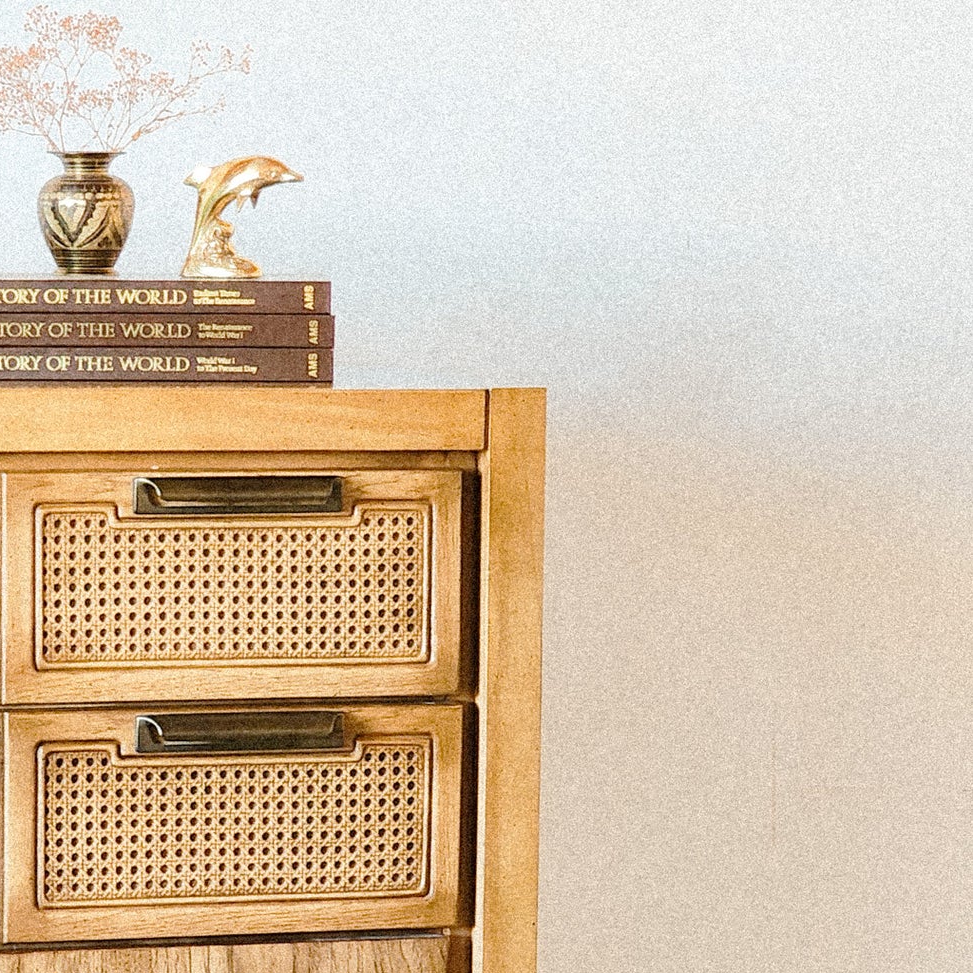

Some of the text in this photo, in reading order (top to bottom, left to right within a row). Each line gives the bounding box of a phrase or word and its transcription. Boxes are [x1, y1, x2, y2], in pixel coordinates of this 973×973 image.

[43, 288, 69, 304] OF
[73, 288, 111, 305] THE
[116, 289, 187, 305] WORLD
[303, 284, 315, 311] AMS
[48, 322, 73, 338] OF
[77, 322, 115, 338] THE
[120, 323, 191, 338] WORLD
[308, 320, 319, 345] AMS
[46, 356, 71, 371] OF
[74, 356, 113, 371] THE
[118, 356, 190, 372] WORLD
[244, 365, 258, 374] Day
[308, 353, 318, 378] AMS
